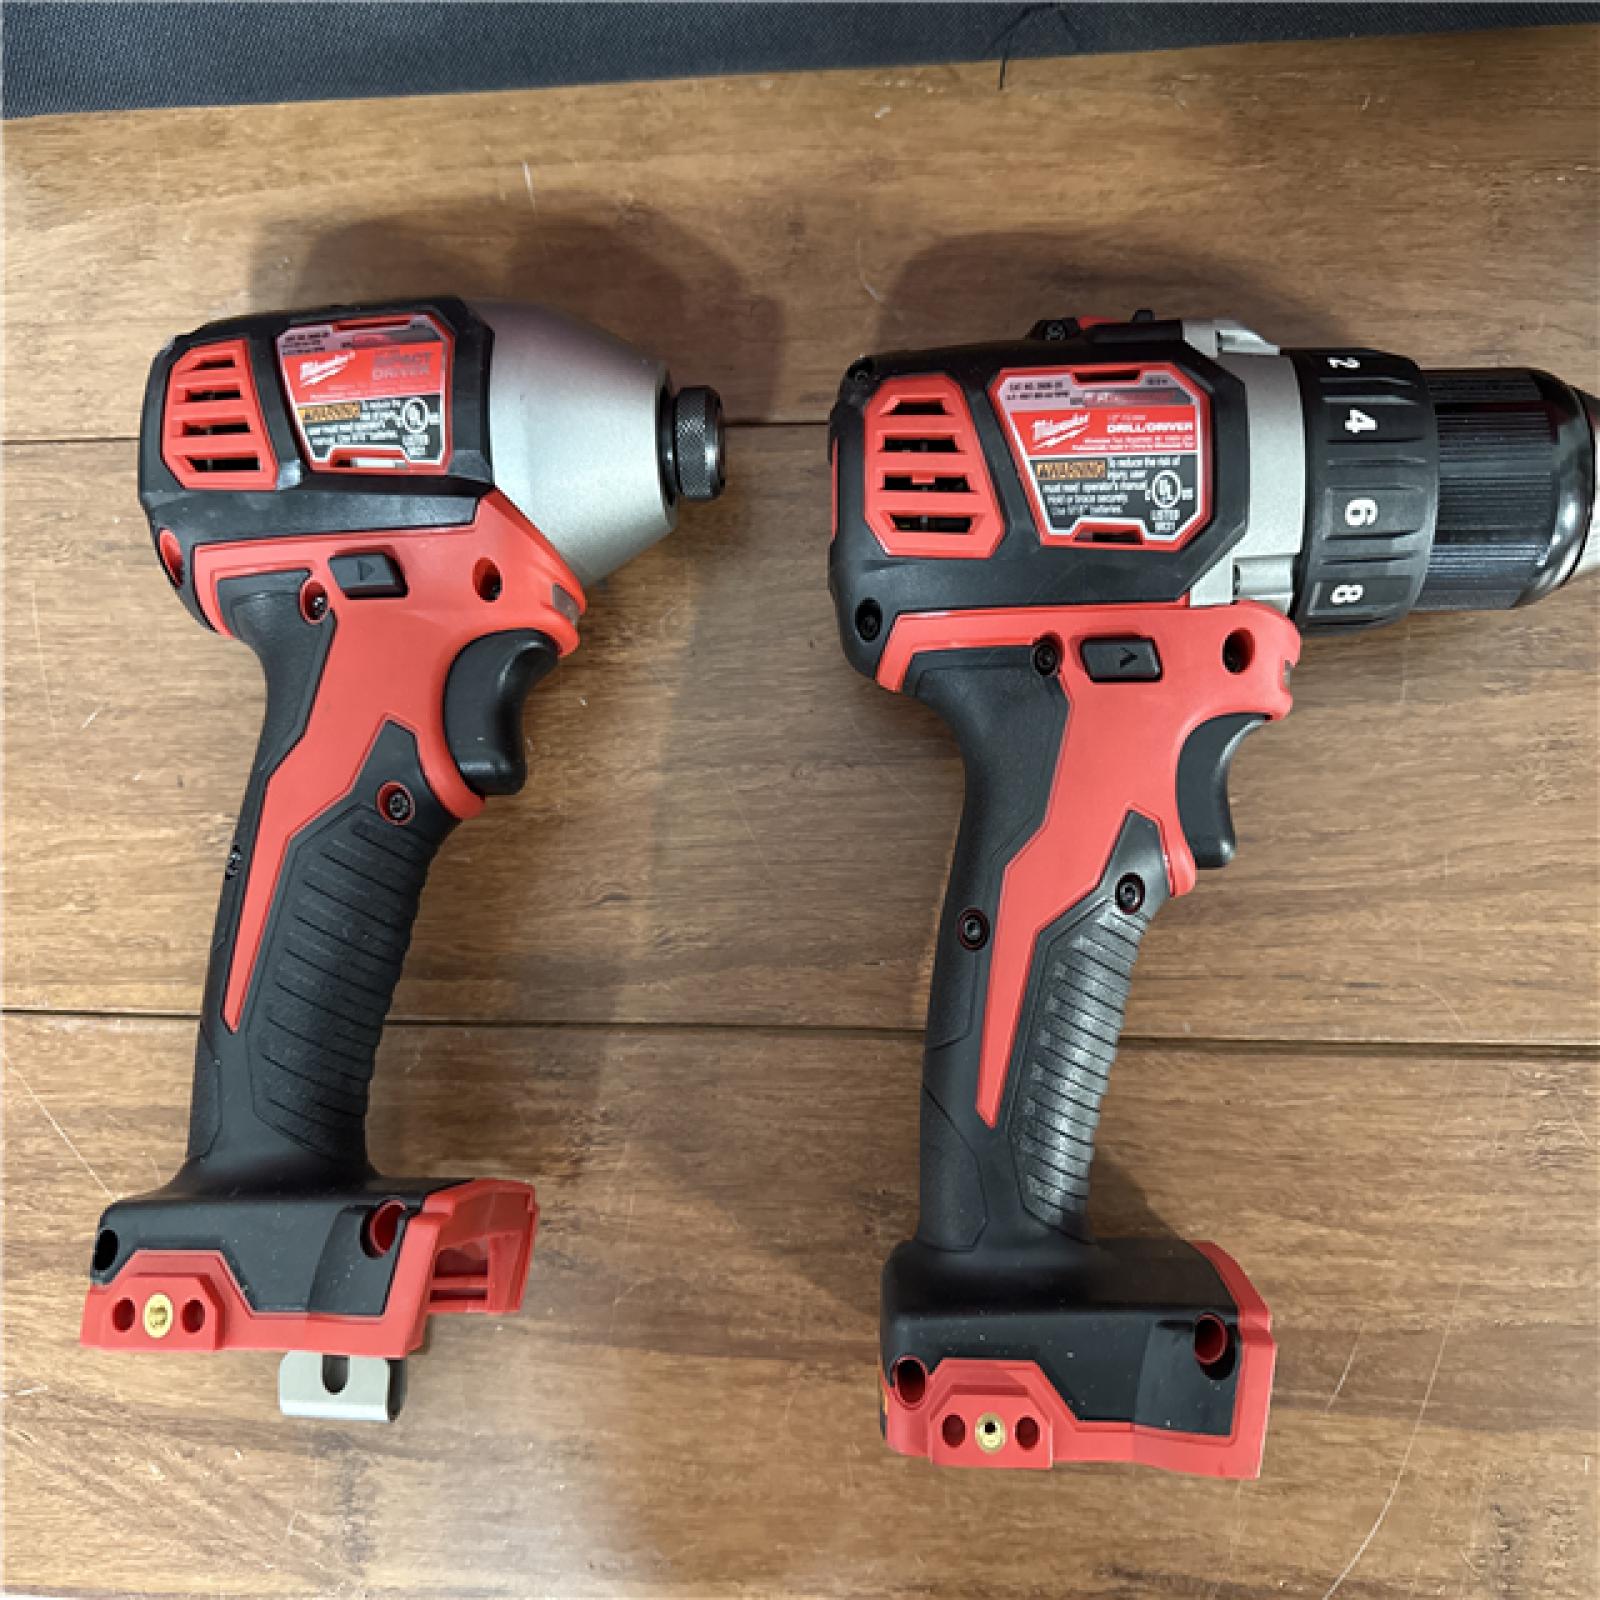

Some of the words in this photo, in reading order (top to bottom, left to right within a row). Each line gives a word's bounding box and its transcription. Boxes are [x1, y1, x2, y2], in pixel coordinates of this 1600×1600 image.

[1327, 357, 1361, 369] 2
[1107, 422, 1193, 433] DRILL/DRIVER
[1344, 407, 1378, 434] 4
[1344, 498, 1378, 526] 6
[1330, 584, 1364, 604] 8
